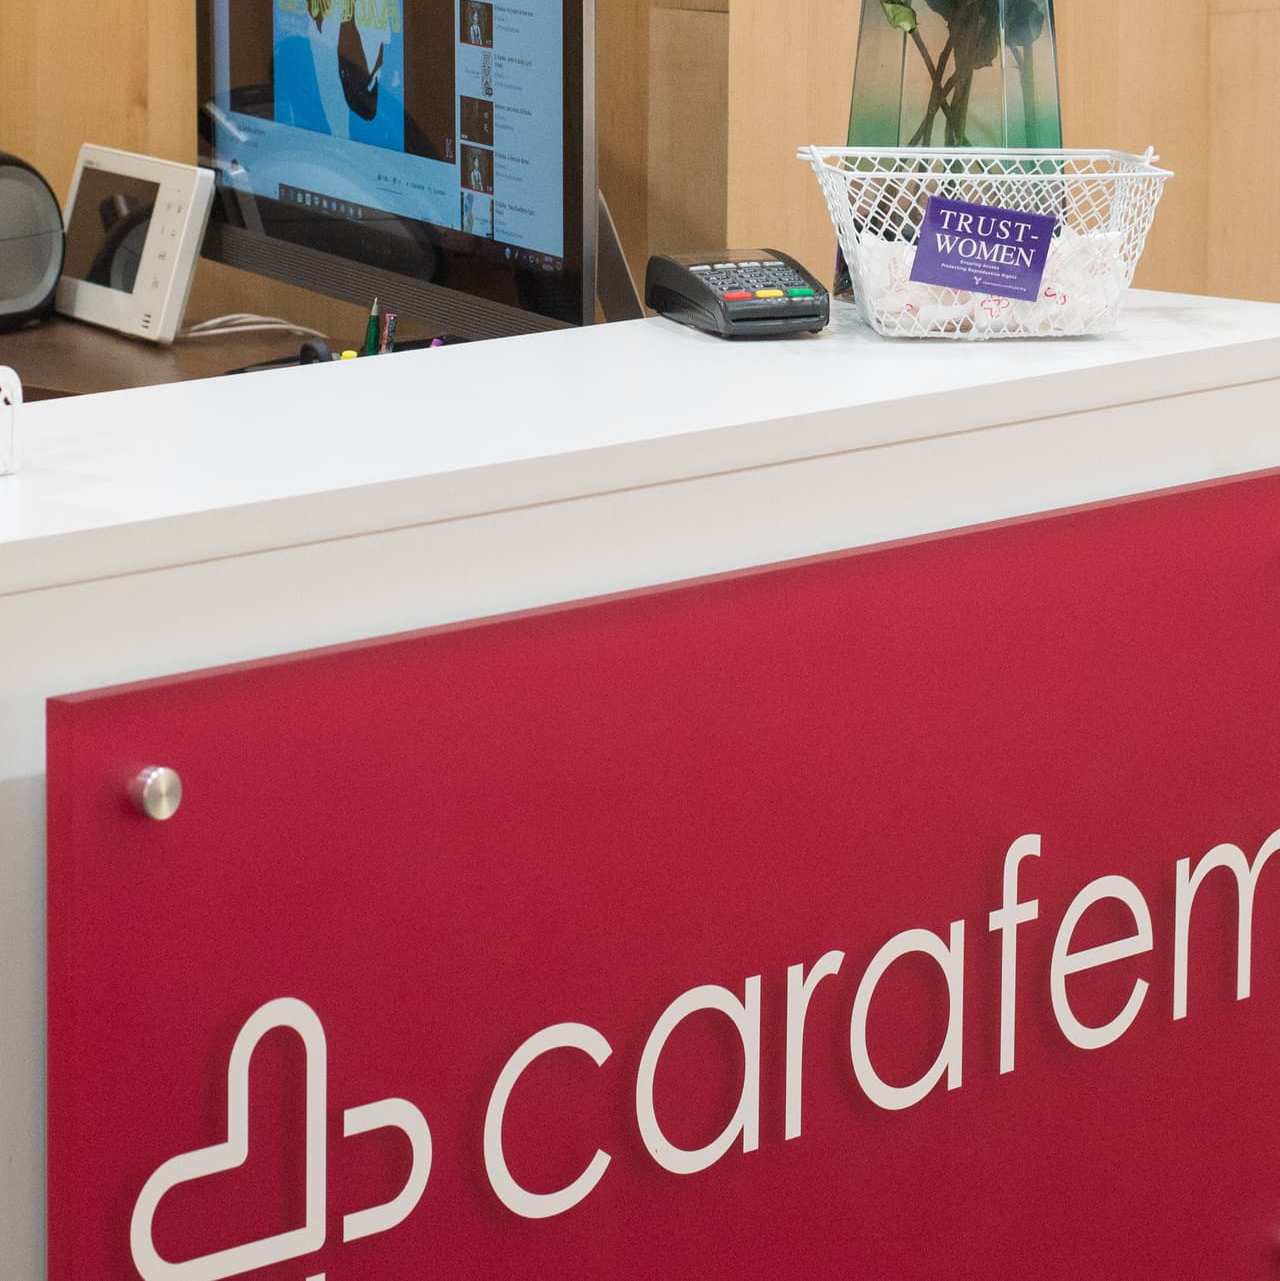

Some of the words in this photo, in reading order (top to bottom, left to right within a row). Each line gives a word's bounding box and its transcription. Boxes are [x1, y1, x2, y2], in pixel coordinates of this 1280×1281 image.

[936, 233, 1036, 268] WOMEN
[941, 263, 966, 272] Protecting
[968, 267, 1001, 277] Reproductive
[1001, 272, 1017, 280] Rights
[960, 259, 981, 268] Ensuring
